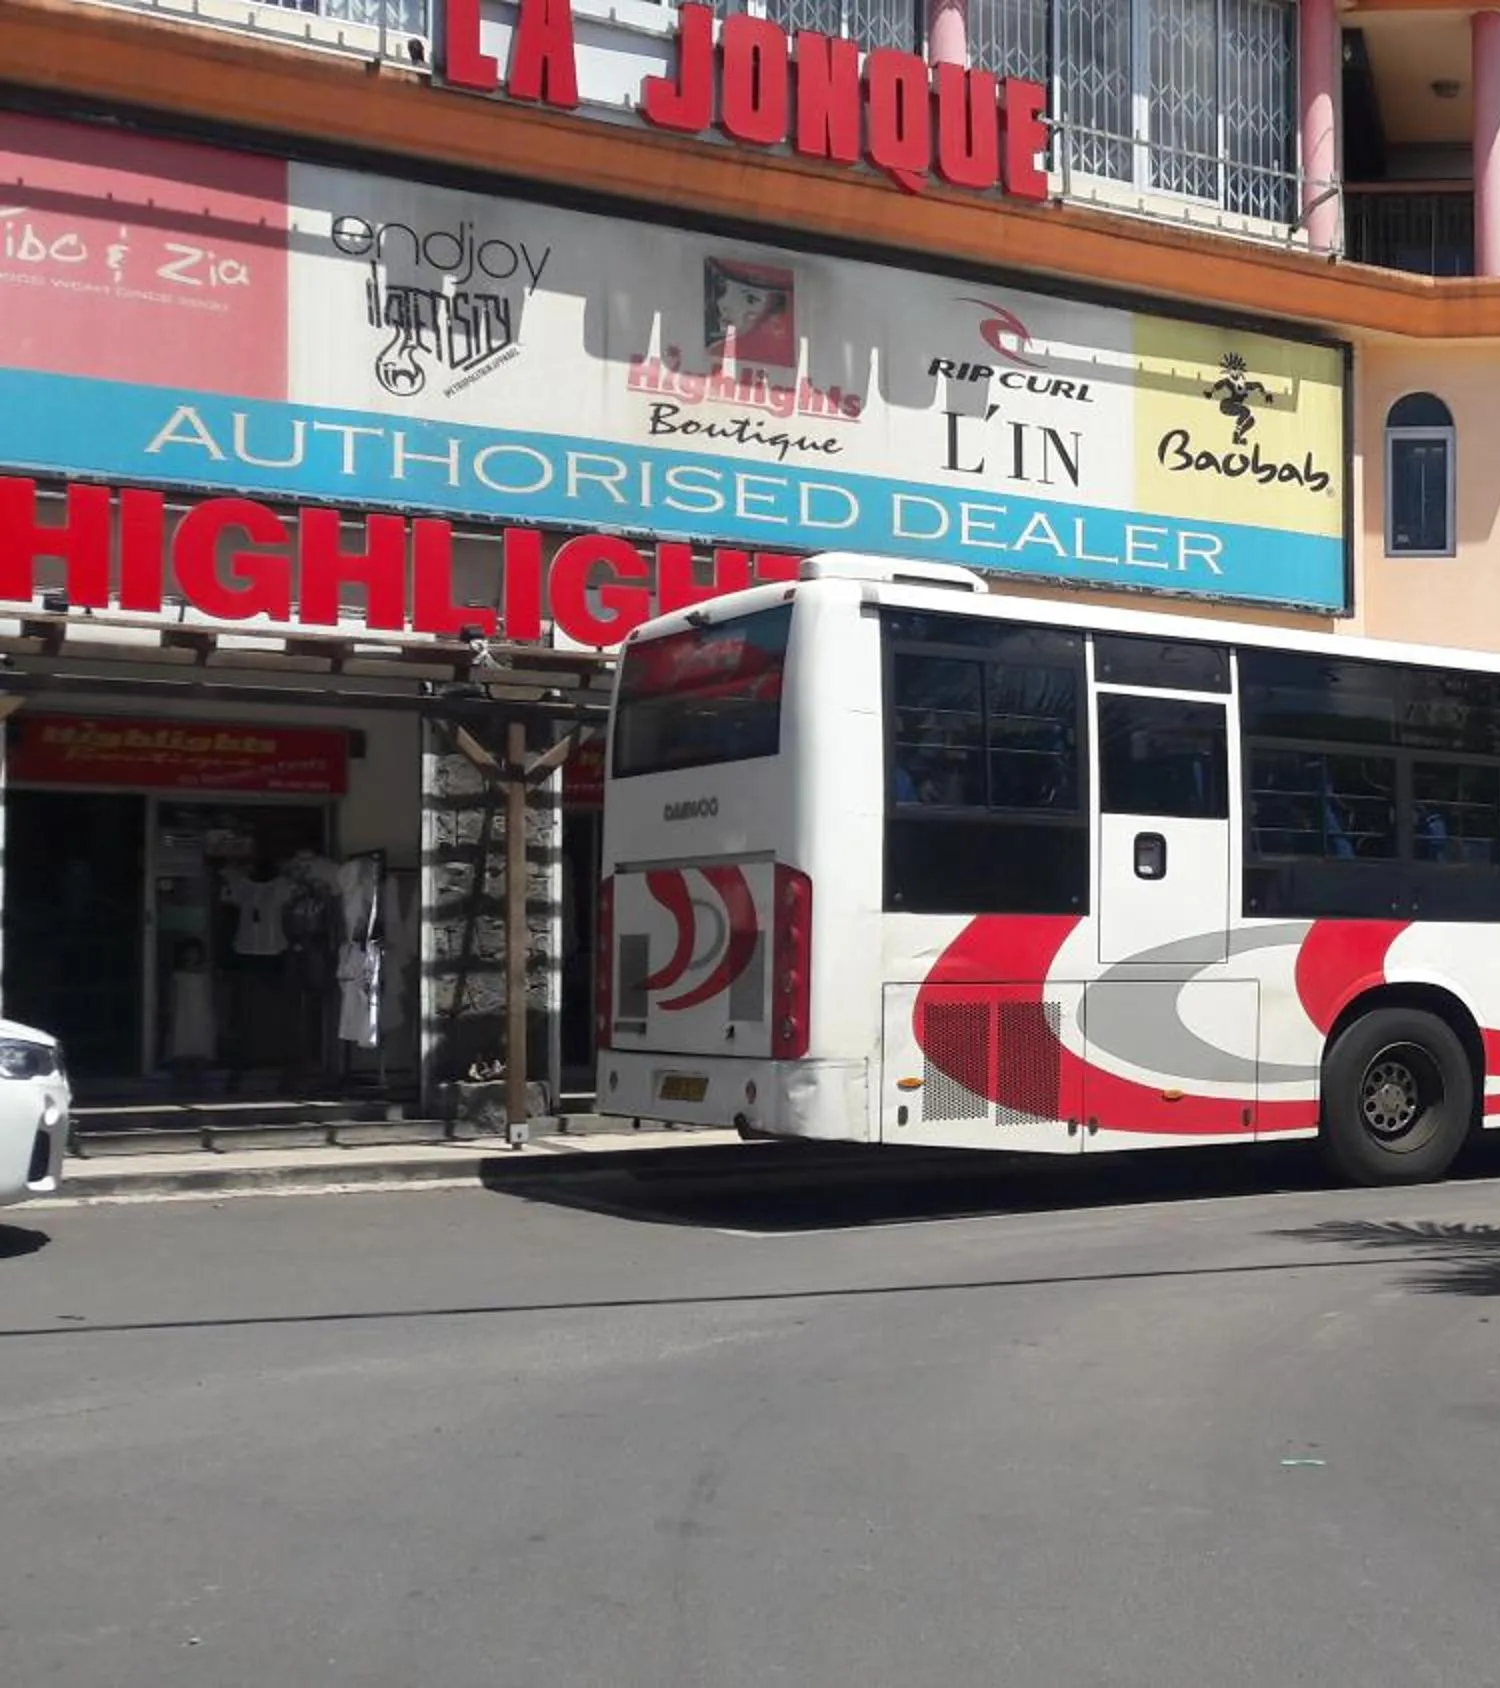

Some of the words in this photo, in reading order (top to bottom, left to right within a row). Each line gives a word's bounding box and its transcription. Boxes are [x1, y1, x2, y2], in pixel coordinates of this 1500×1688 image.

[445, 0, 578, 108] LA
[641, 2, 1048, 199] JONQUE
[157, 242, 250, 287] Zia
[332, 215, 551, 296] endjoy
[628, 345, 862, 420] Highlights
[928, 358, 994, 382] RIP
[1000, 372, 1094, 403] CURL
[648, 403, 843, 461] Boutique
[941, 404, 1083, 487] L'IN
[1158, 429, 1330, 492] Baobab
[144, 405, 858, 529] AUTHORISED
[892, 493, 1225, 576] DEALER
